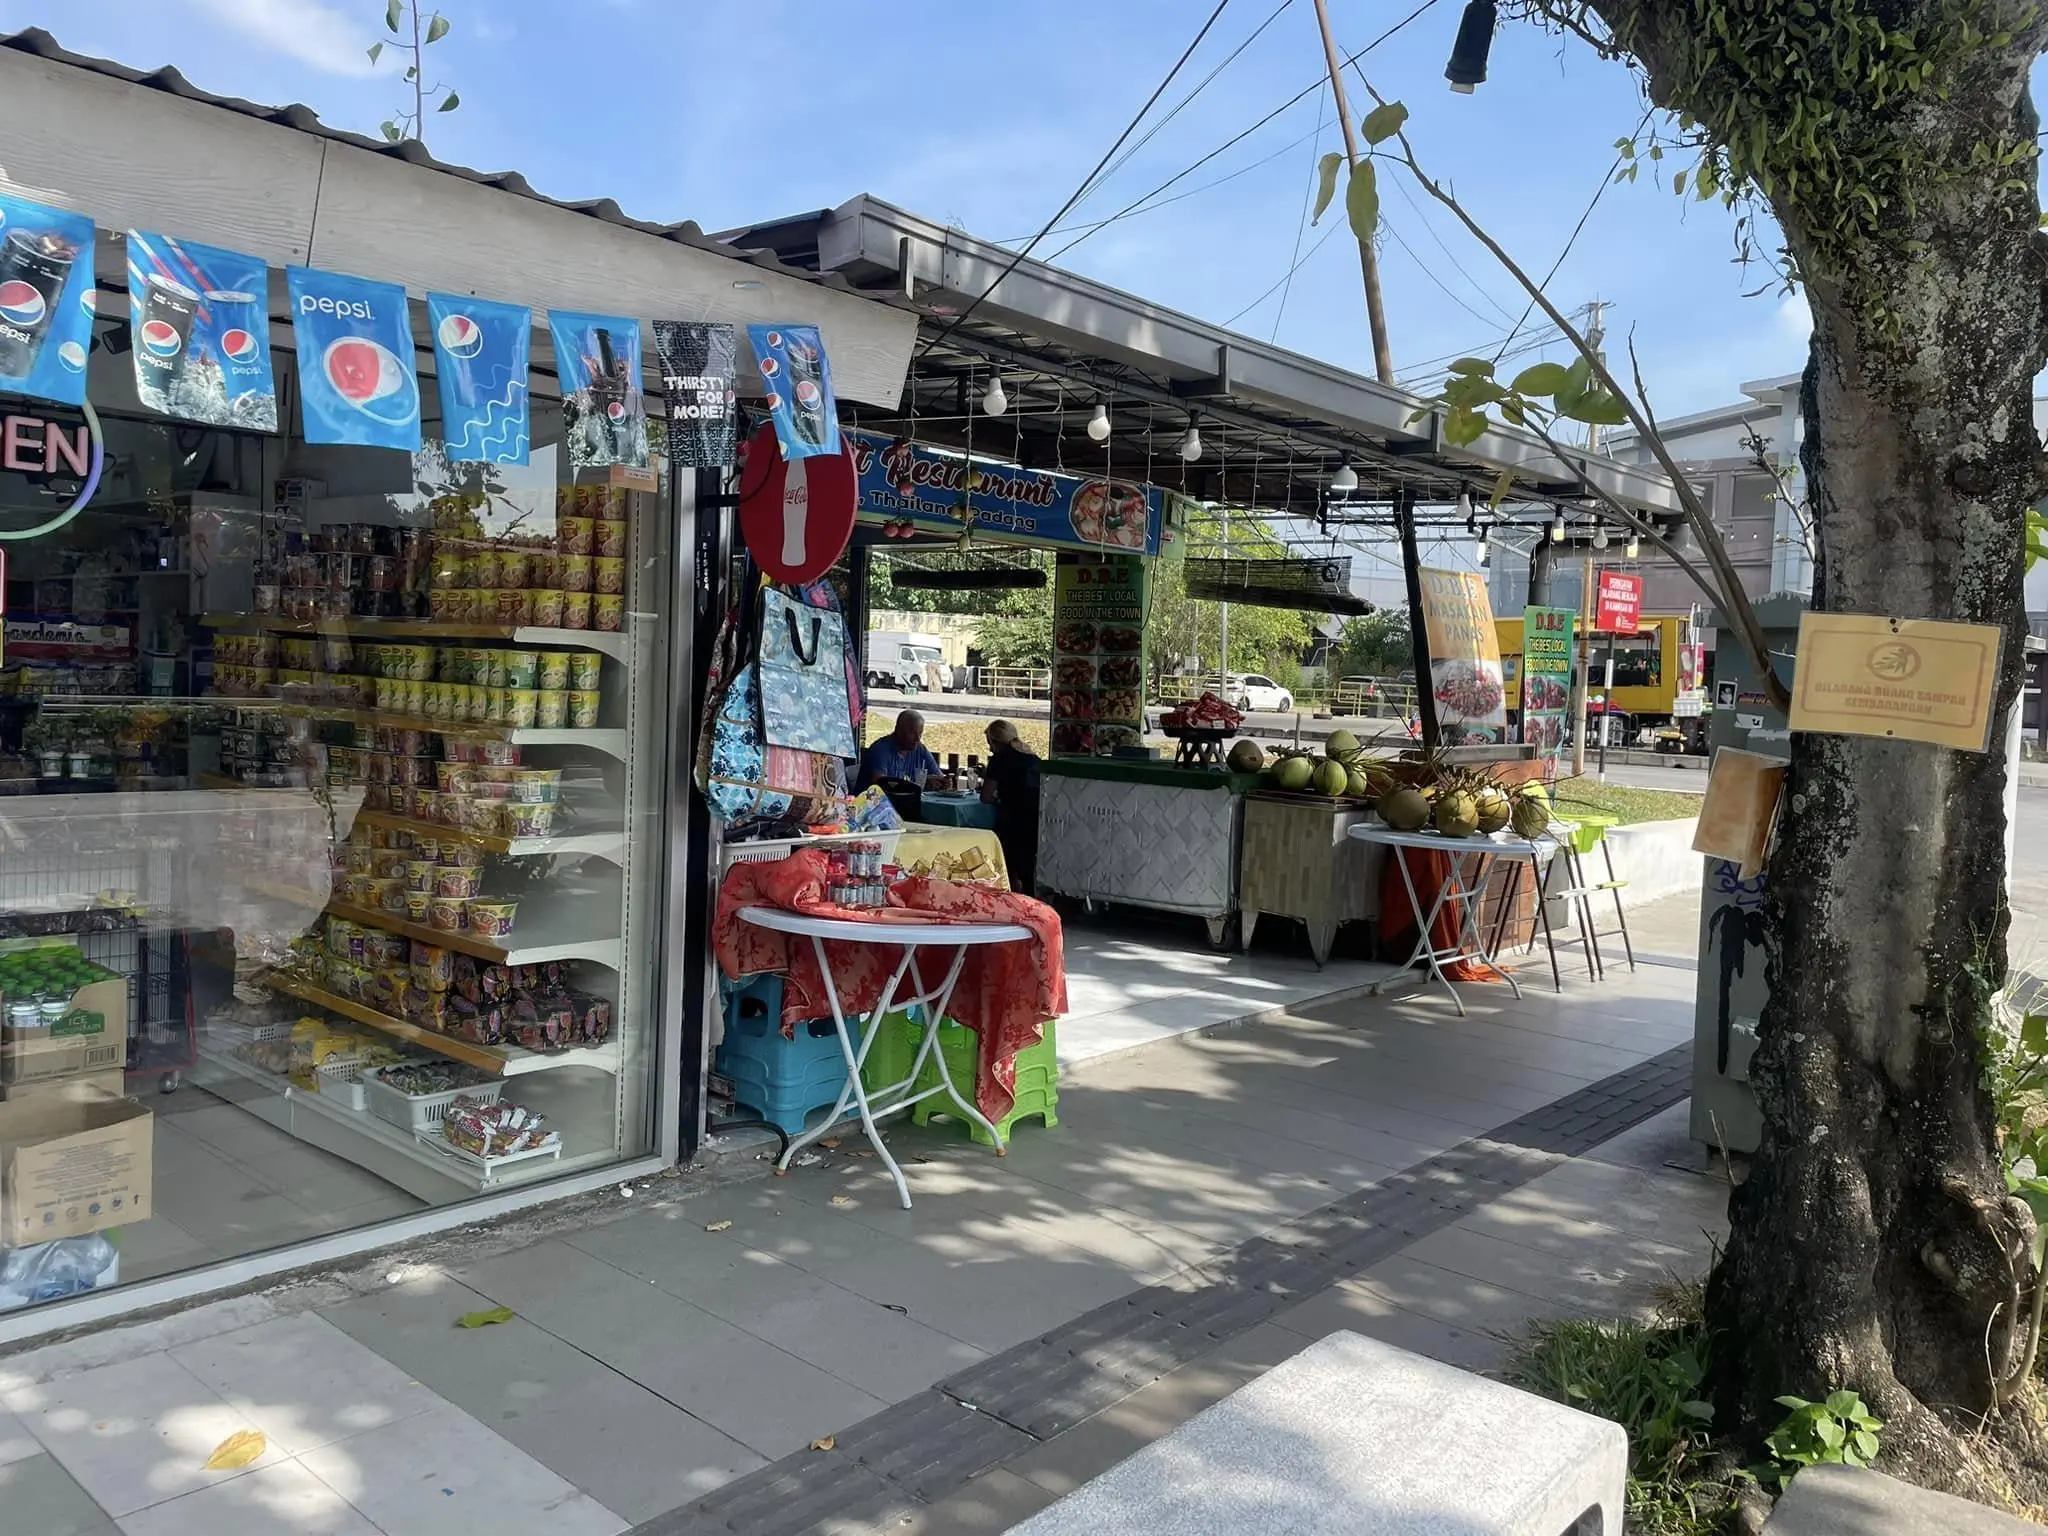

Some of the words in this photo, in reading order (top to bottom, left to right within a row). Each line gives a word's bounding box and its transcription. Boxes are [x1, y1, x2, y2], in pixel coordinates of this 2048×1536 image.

[300, 295, 376, 320] pepsi
[0, 324, 31, 344] epsi
[139, 351, 174, 371] pepsi
[663, 376, 724, 391] THIRSTY
[696, 390, 724, 405] FOR
[673, 405, 725, 420] MORE?
[0, 415, 89, 476] EN
[870, 489, 953, 517] Thailan
[1109, 590, 1137, 602] LOCAL
[1115, 607, 1141, 620] TOWN
[6, 621, 85, 642] ardenia
[1814, 682, 1871, 696] DILARANG
[1875, 686, 1914, 700] BUANG
[68, 1015, 89, 1026] ICE
